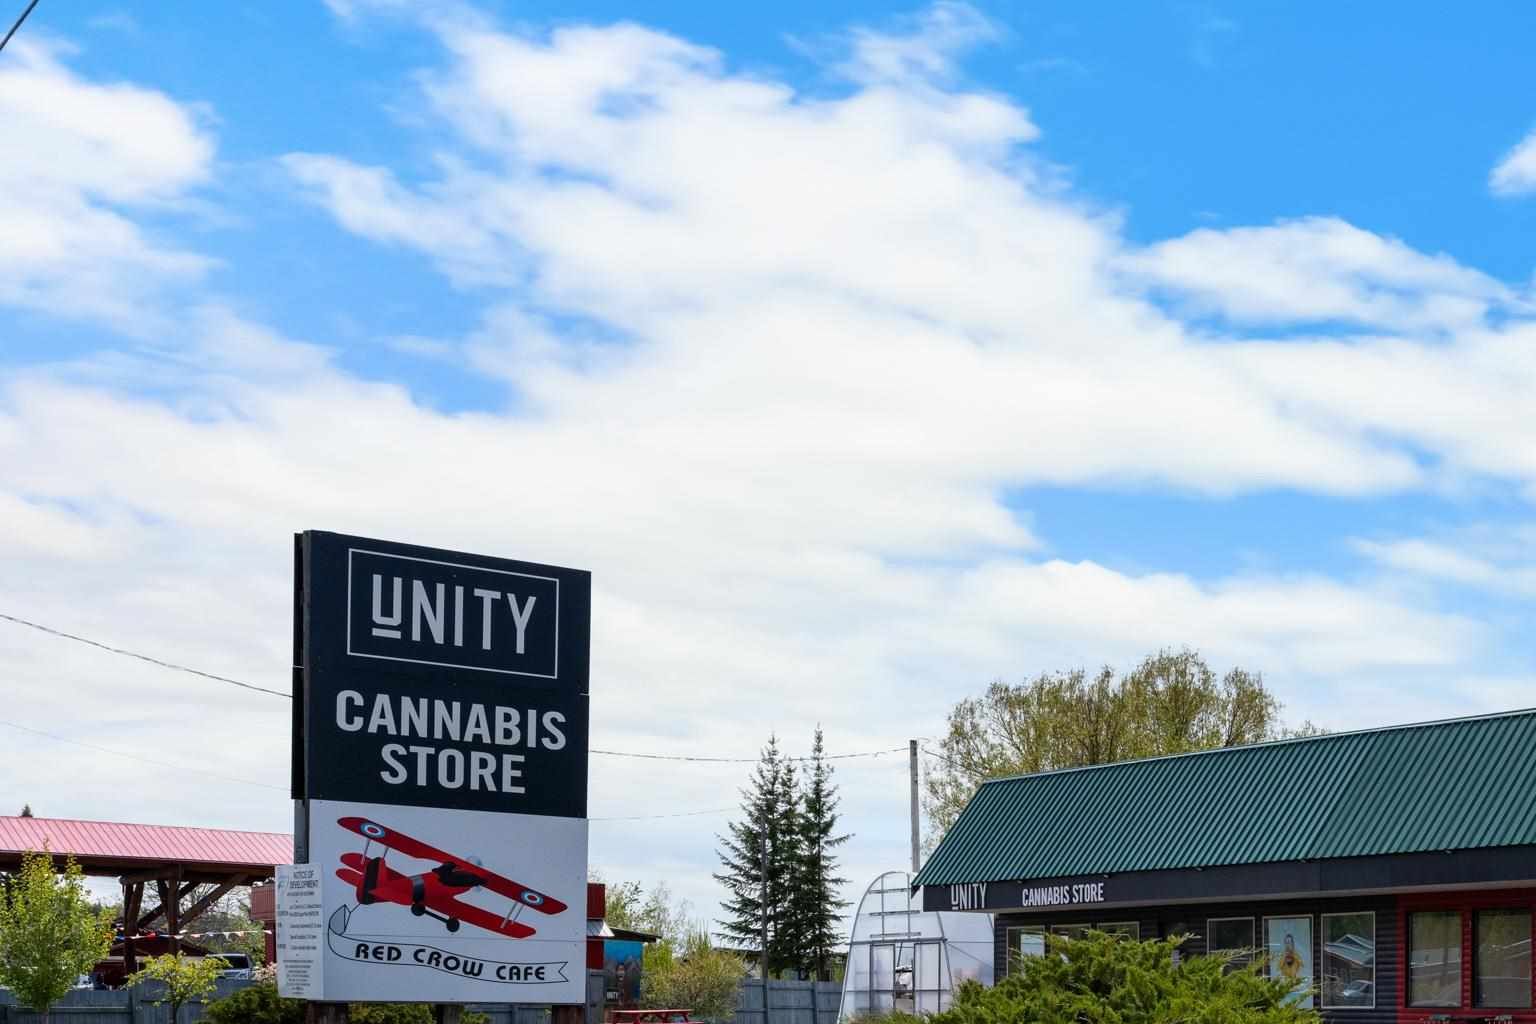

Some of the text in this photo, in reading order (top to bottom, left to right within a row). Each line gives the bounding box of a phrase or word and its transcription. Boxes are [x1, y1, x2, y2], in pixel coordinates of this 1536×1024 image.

[372, 574, 537, 654] UNITY
[336, 690, 567, 750] CANNABIS
[380, 744, 526, 794] STORE
[951, 883, 987, 910] UNITY
[1022, 883, 1104, 907] CANNABIS STORE
[355, 944, 546, 982] RED CROW CAFE
